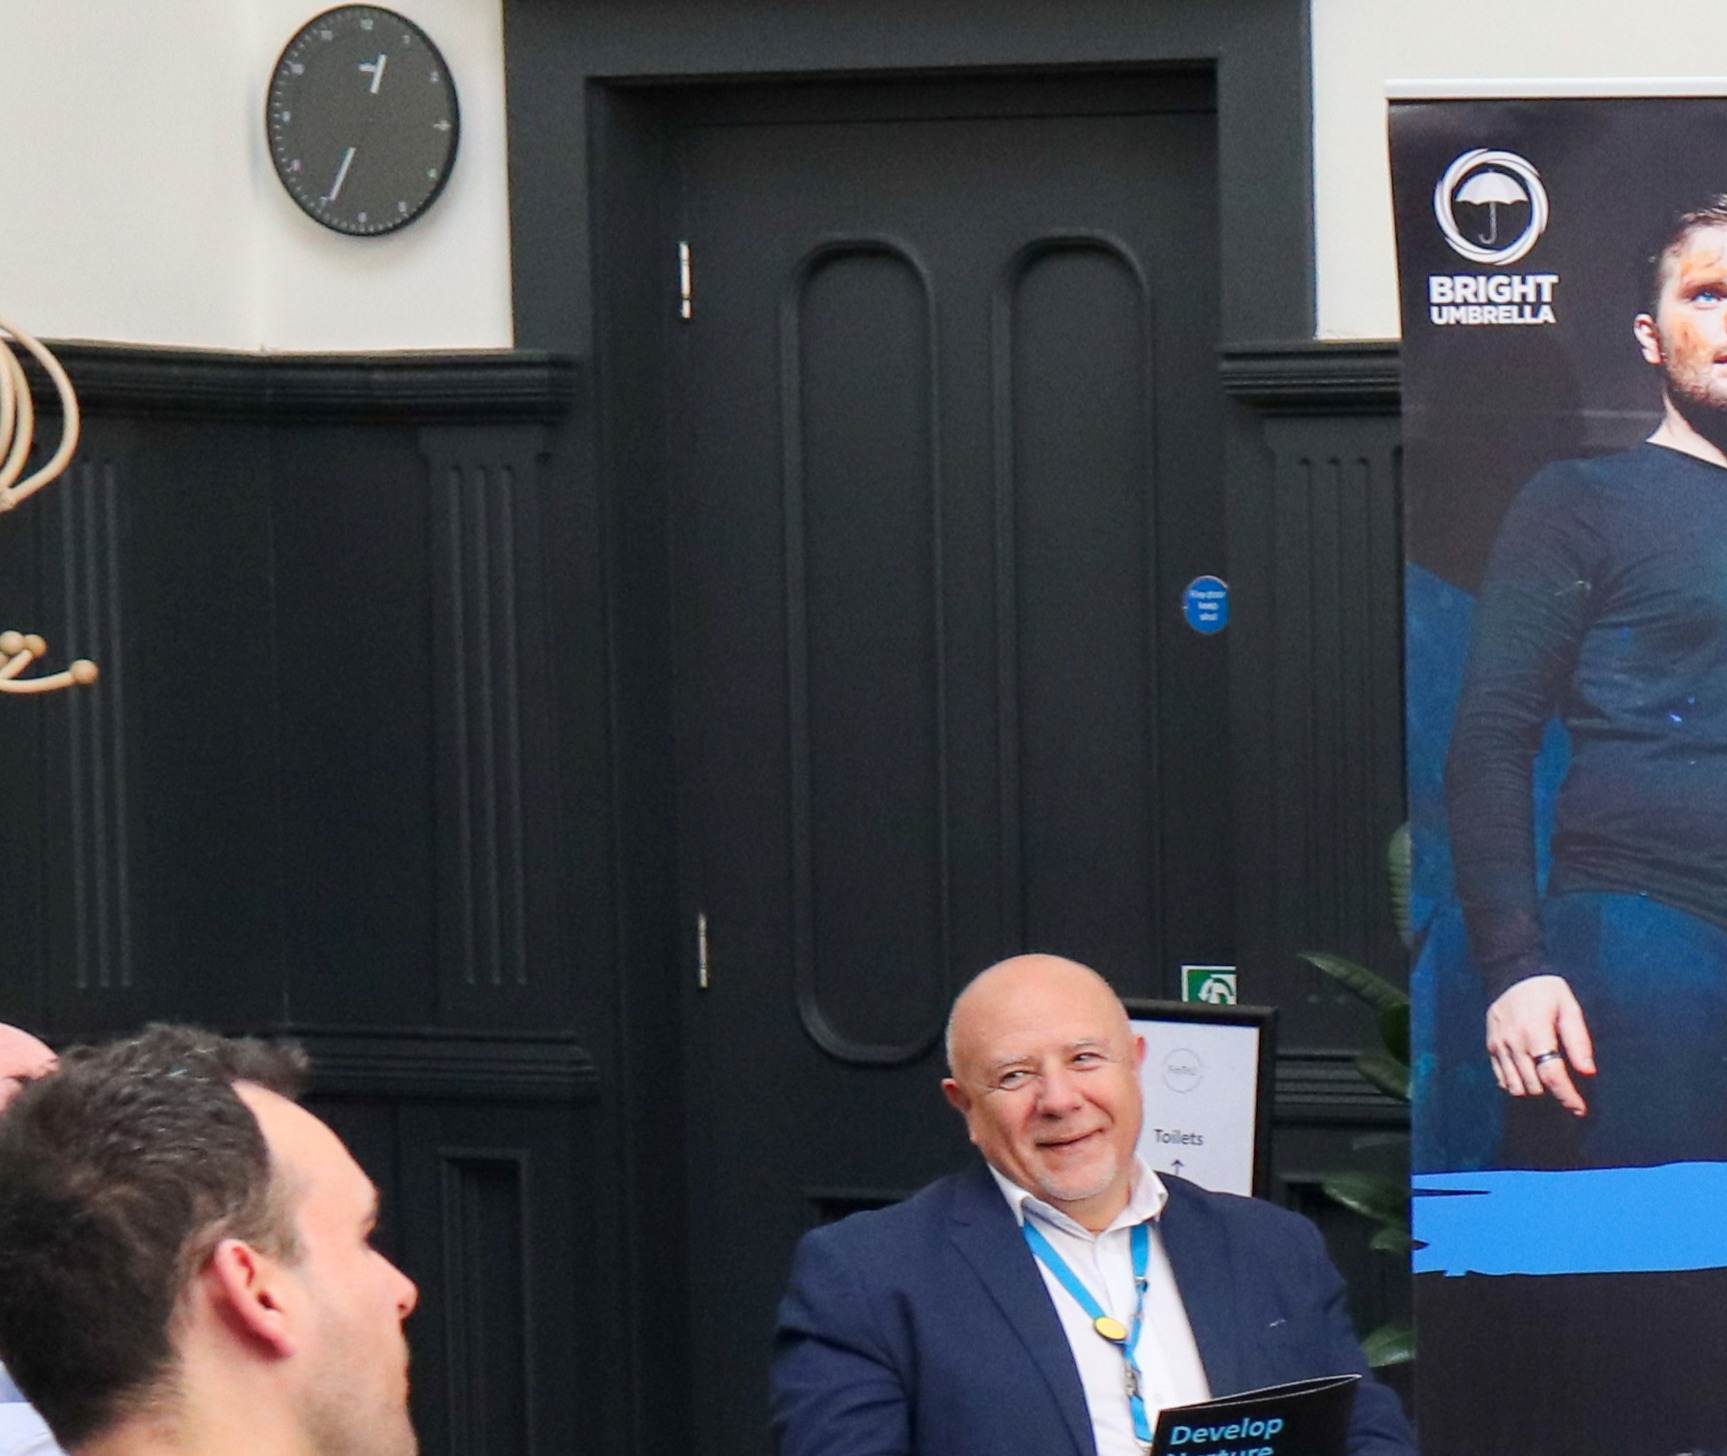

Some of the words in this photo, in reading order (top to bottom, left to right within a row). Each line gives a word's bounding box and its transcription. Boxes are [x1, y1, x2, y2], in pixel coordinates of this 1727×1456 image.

[1429, 275, 1559, 304] BRIGHT
[1430, 304, 1556, 325] UMBRELLA
[1154, 1128, 1204, 1146] Toilets
[1170, 1417, 1283, 1446] Develop
